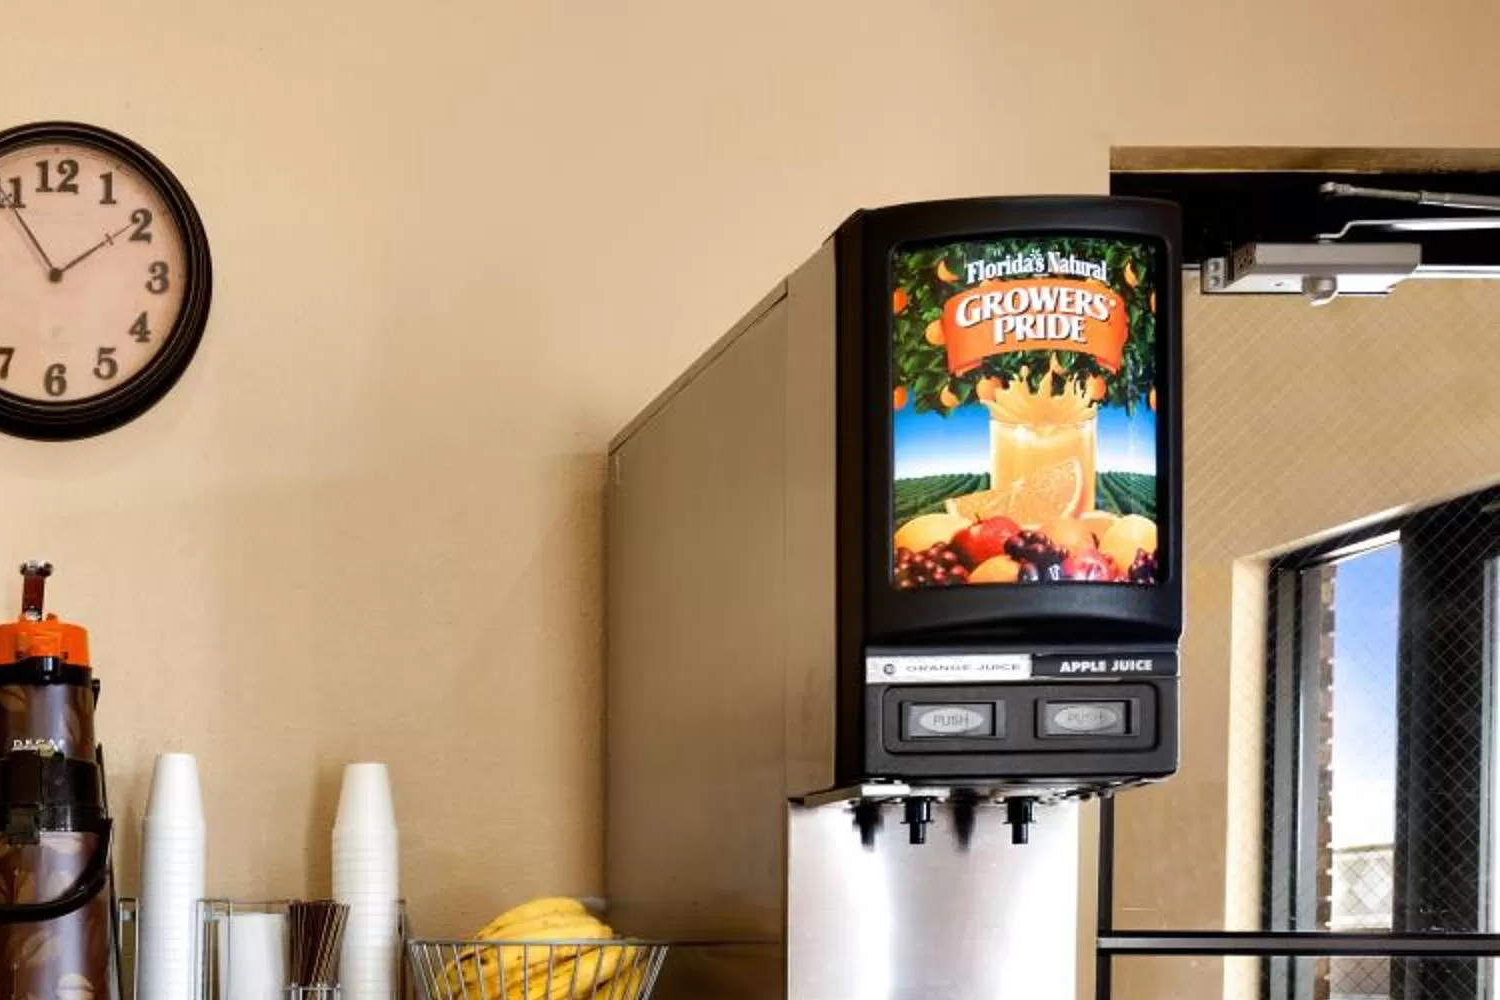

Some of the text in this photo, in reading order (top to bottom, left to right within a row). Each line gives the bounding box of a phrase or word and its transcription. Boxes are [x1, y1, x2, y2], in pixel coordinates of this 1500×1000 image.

[35, 159, 79, 194] 12
[99, 172, 117, 204] 1
[128, 208, 153, 243] 2
[145, 261, 169, 295] 3
[966, 250, 1107, 284] Florida's Natural
[129, 311, 151, 343] 4
[993, 315, 1087, 344] PRIDE
[93, 347, 118, 380] 5
[44, 363, 67, 397] 6
[905, 663, 971, 672] ORANGE
[976, 662, 1021, 671] JUICE
[1060, 659, 1153, 673] APPLE JUICE
[932, 713, 969, 728] PUSH
